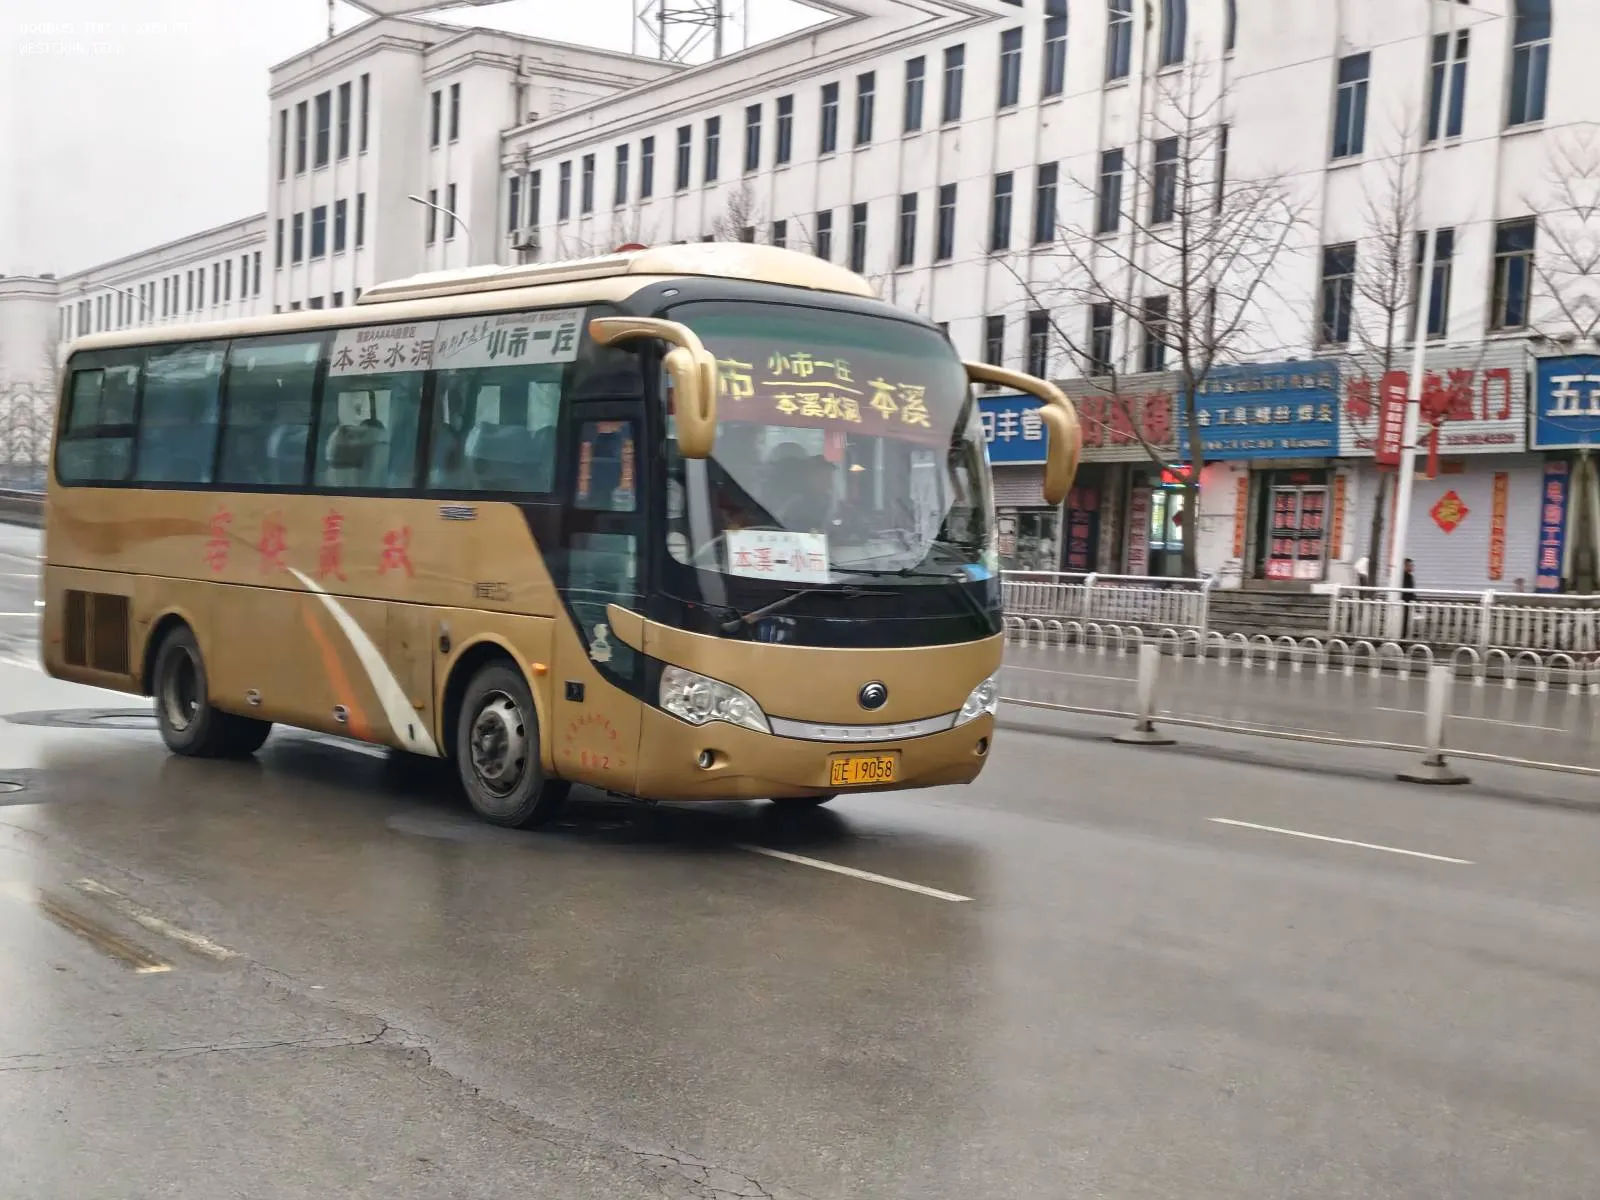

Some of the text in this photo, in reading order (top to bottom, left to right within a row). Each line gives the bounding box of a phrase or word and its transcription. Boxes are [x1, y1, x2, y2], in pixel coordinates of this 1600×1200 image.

[332, 338, 434, 371] 本溪水洞
[866, 375, 932, 428] 本溪
